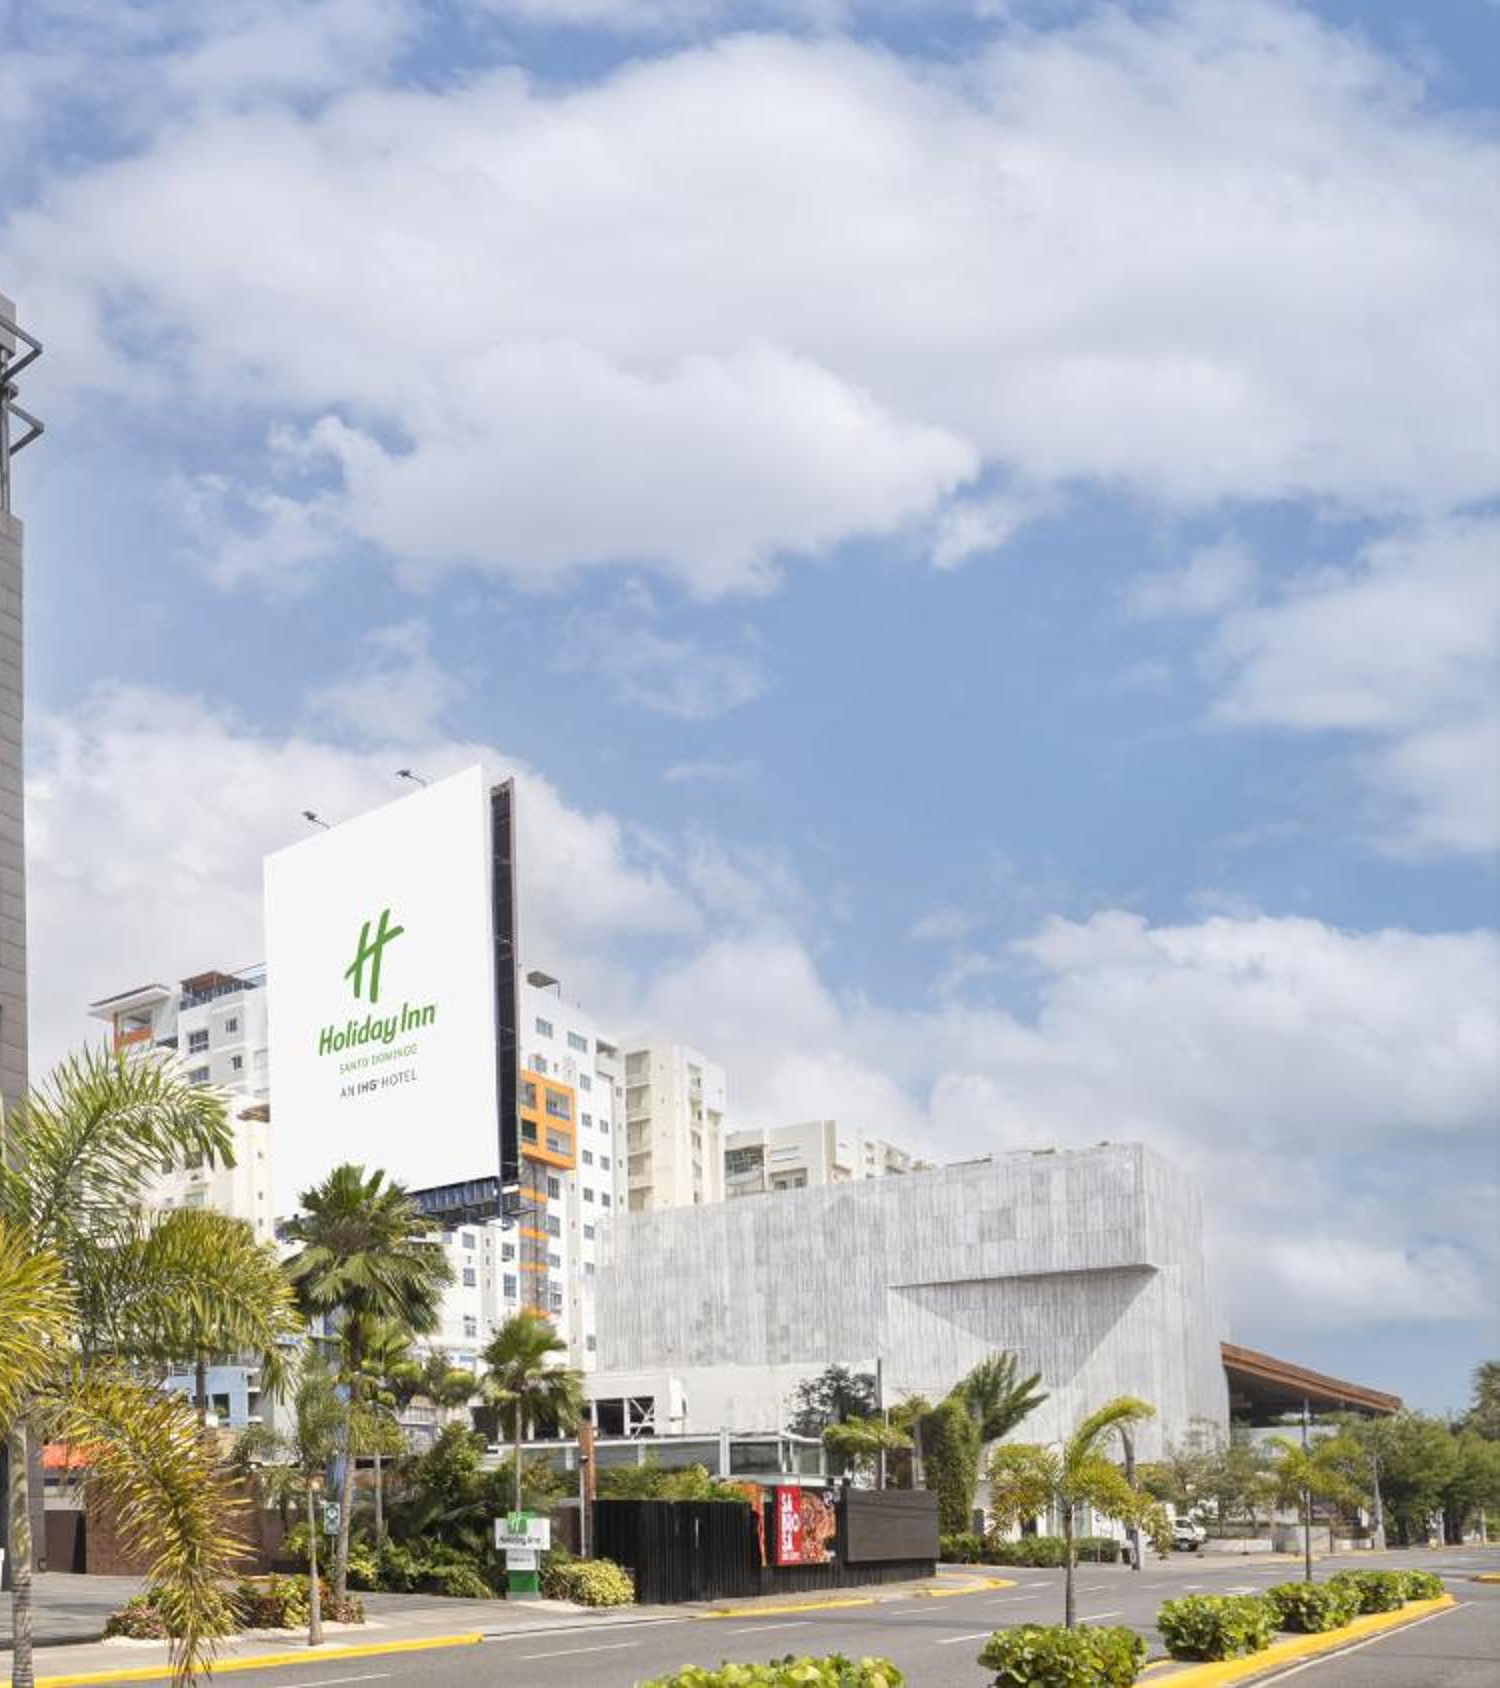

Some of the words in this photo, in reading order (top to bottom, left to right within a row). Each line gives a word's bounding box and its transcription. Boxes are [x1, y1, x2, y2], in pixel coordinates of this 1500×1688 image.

[319, 1014, 398, 1056] Holiday
[401, 1002, 435, 1032] Inn
[340, 1057, 368, 1075] SANTO
[371, 1043, 418, 1066] DOMINGO
[340, 1084, 355, 1097] AN
[357, 1079, 377, 1096] IHG
[381, 1068, 417, 1088] HOTEL
